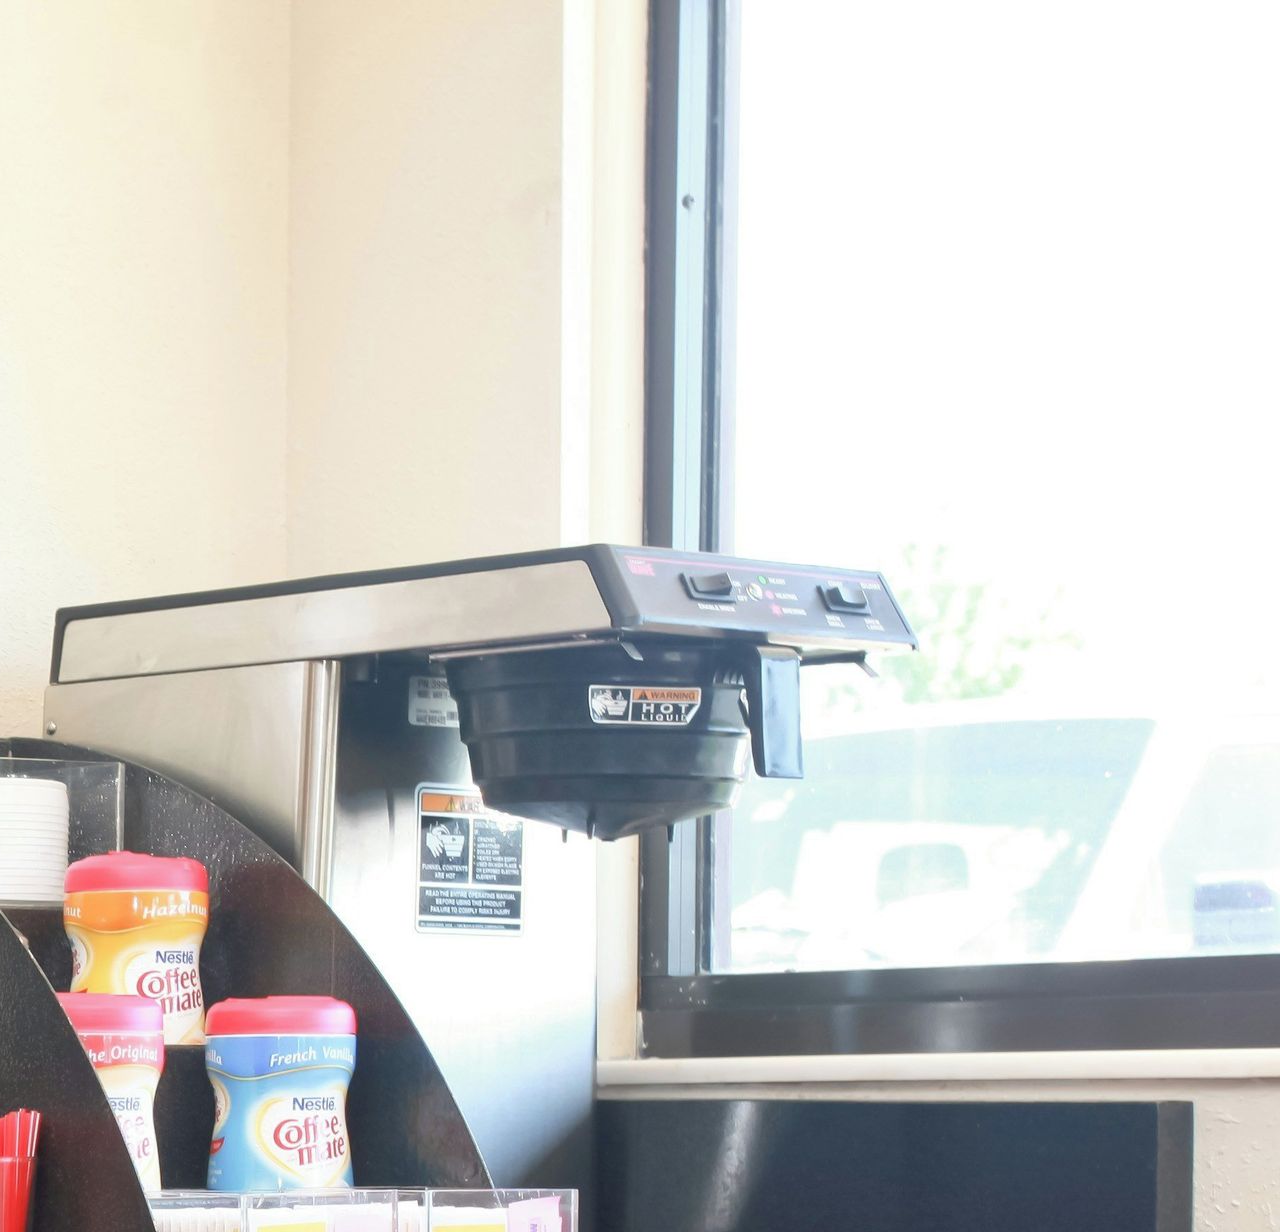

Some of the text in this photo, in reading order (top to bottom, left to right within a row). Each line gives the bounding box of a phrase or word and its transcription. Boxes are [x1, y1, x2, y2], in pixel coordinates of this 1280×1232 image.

[650, 692, 695, 700] WARNING
[642, 703, 689, 714] HOT
[160, 988, 202, 1014] mate
[110, 1045, 158, 1062] Original
[270, 1046, 354, 1068] French Vanilla
[107, 1097, 140, 1112] estlé
